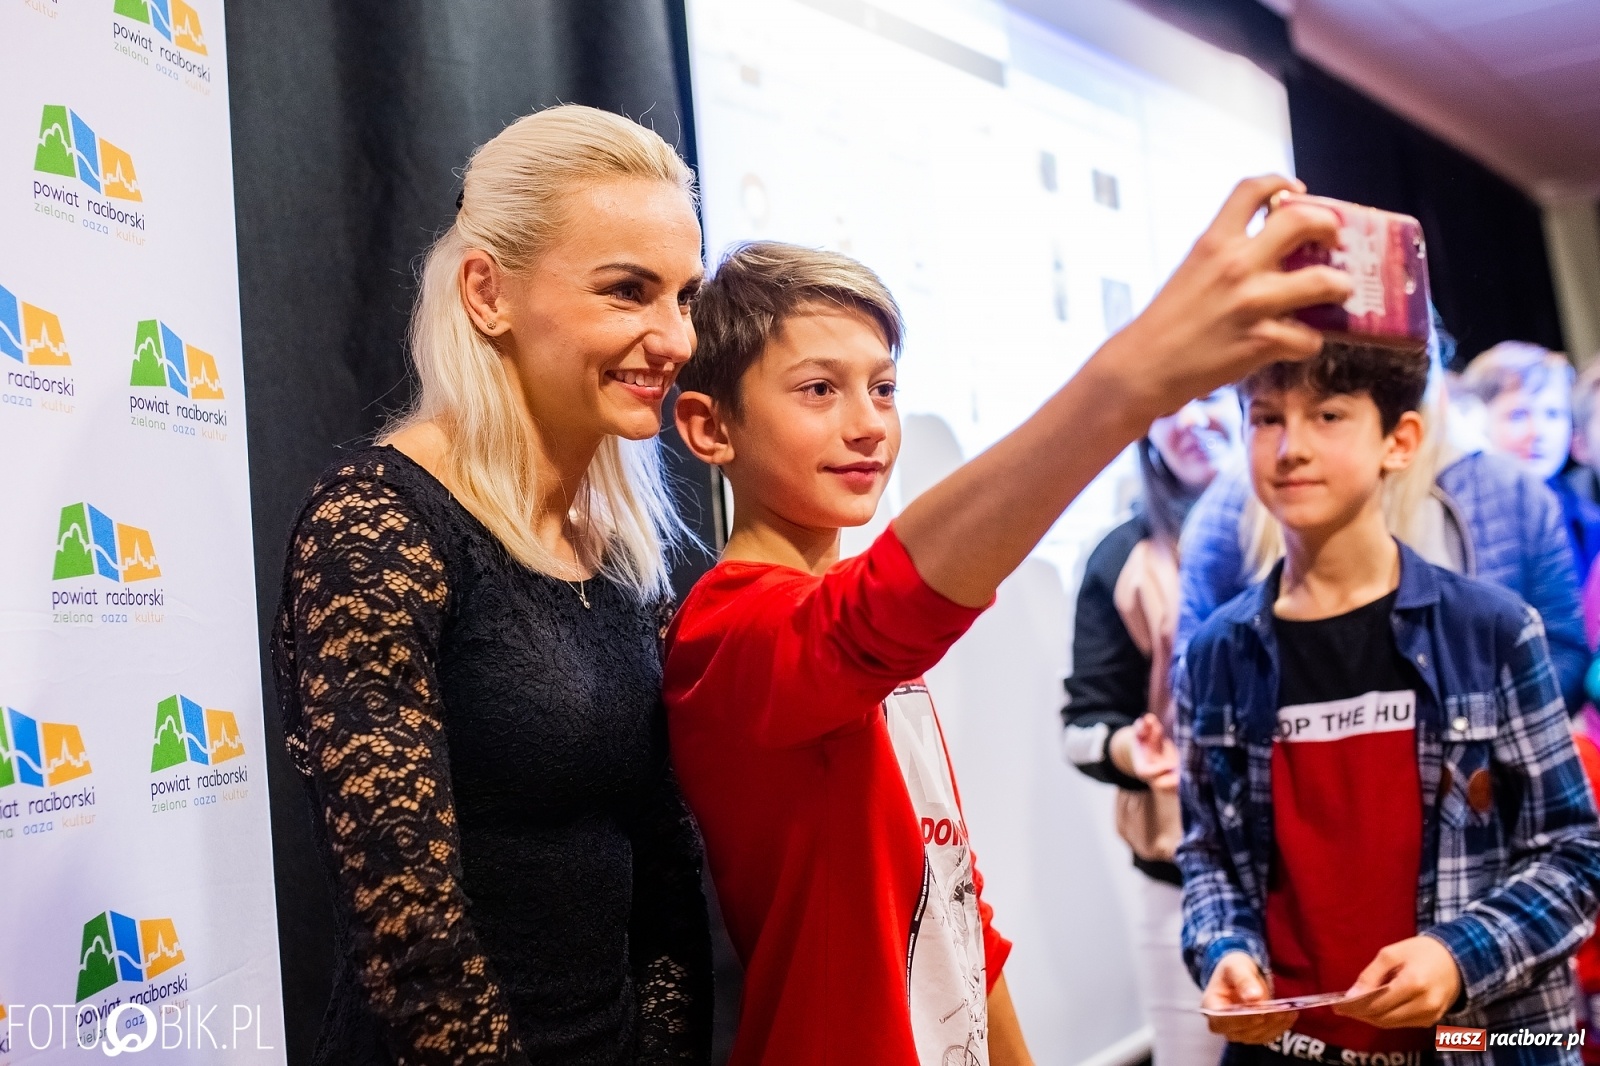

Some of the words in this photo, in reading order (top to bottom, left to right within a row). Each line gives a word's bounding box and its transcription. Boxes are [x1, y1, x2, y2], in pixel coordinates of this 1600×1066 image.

[112, 21, 153, 53] powiat
[159, 44, 211, 83] raciborski
[113, 41, 149, 66] zielona
[155, 62, 179, 81] oaza
[184, 75, 211, 97] kultur
[33, 180, 80, 208] powiat
[87, 197, 145, 231] raciborski
[34, 202, 75, 224] zielona
[82, 217, 109, 235] oaza
[116, 228, 146, 247] kultur
[7, 370, 75, 397] raciborski
[129, 394, 169, 416] powiat
[176, 403, 227, 427] raciborski
[131, 414, 166, 431] zielona
[172, 423, 196, 437] oaza
[201, 426, 228, 442] kultur
[51, 586, 99, 610] powiat
[105, 588, 164, 606] raciborski
[53, 610, 94, 624] zielona
[101, 613, 128, 624] oaza
[135, 611, 164, 624] kultur
[1321, 706, 1365, 732] THE
[150, 774, 190, 800] powiat
[197, 765, 248, 789] raciborski
[28, 786, 96, 815] raciborski
[151, 798, 187, 814] zielona
[193, 793, 217, 807] oaza
[222, 788, 249, 802] kultur
[23, 820, 53, 836] oaza
[61, 813, 97, 828] kultur
